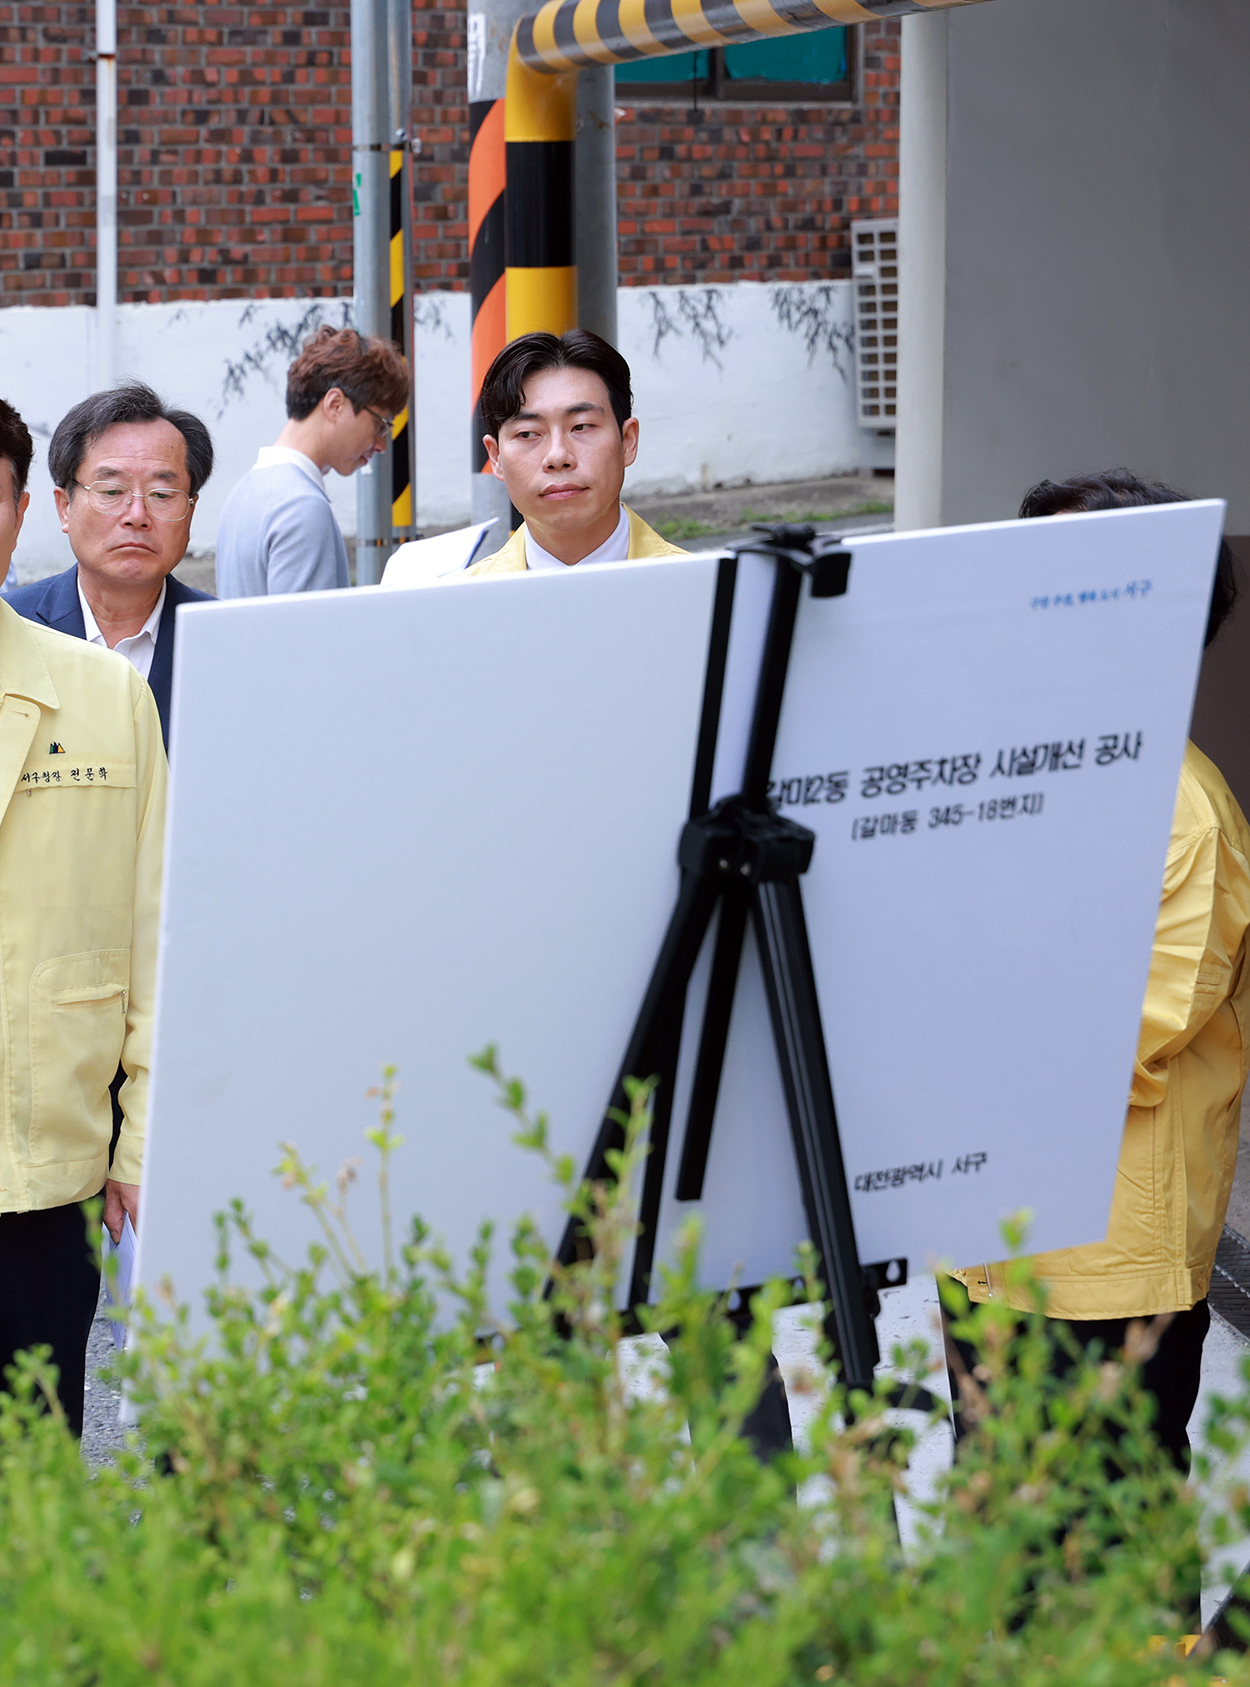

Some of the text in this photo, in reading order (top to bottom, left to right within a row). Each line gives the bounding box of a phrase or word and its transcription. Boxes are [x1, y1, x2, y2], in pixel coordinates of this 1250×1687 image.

[21, 771, 62, 784] 서구청장
[861, 753, 981, 799] 공영주차장
[989, 738, 1085, 777] 시설개선
[1095, 730, 1142, 766] 공사
[853, 1152, 986, 1192] 대전광역시 서구
